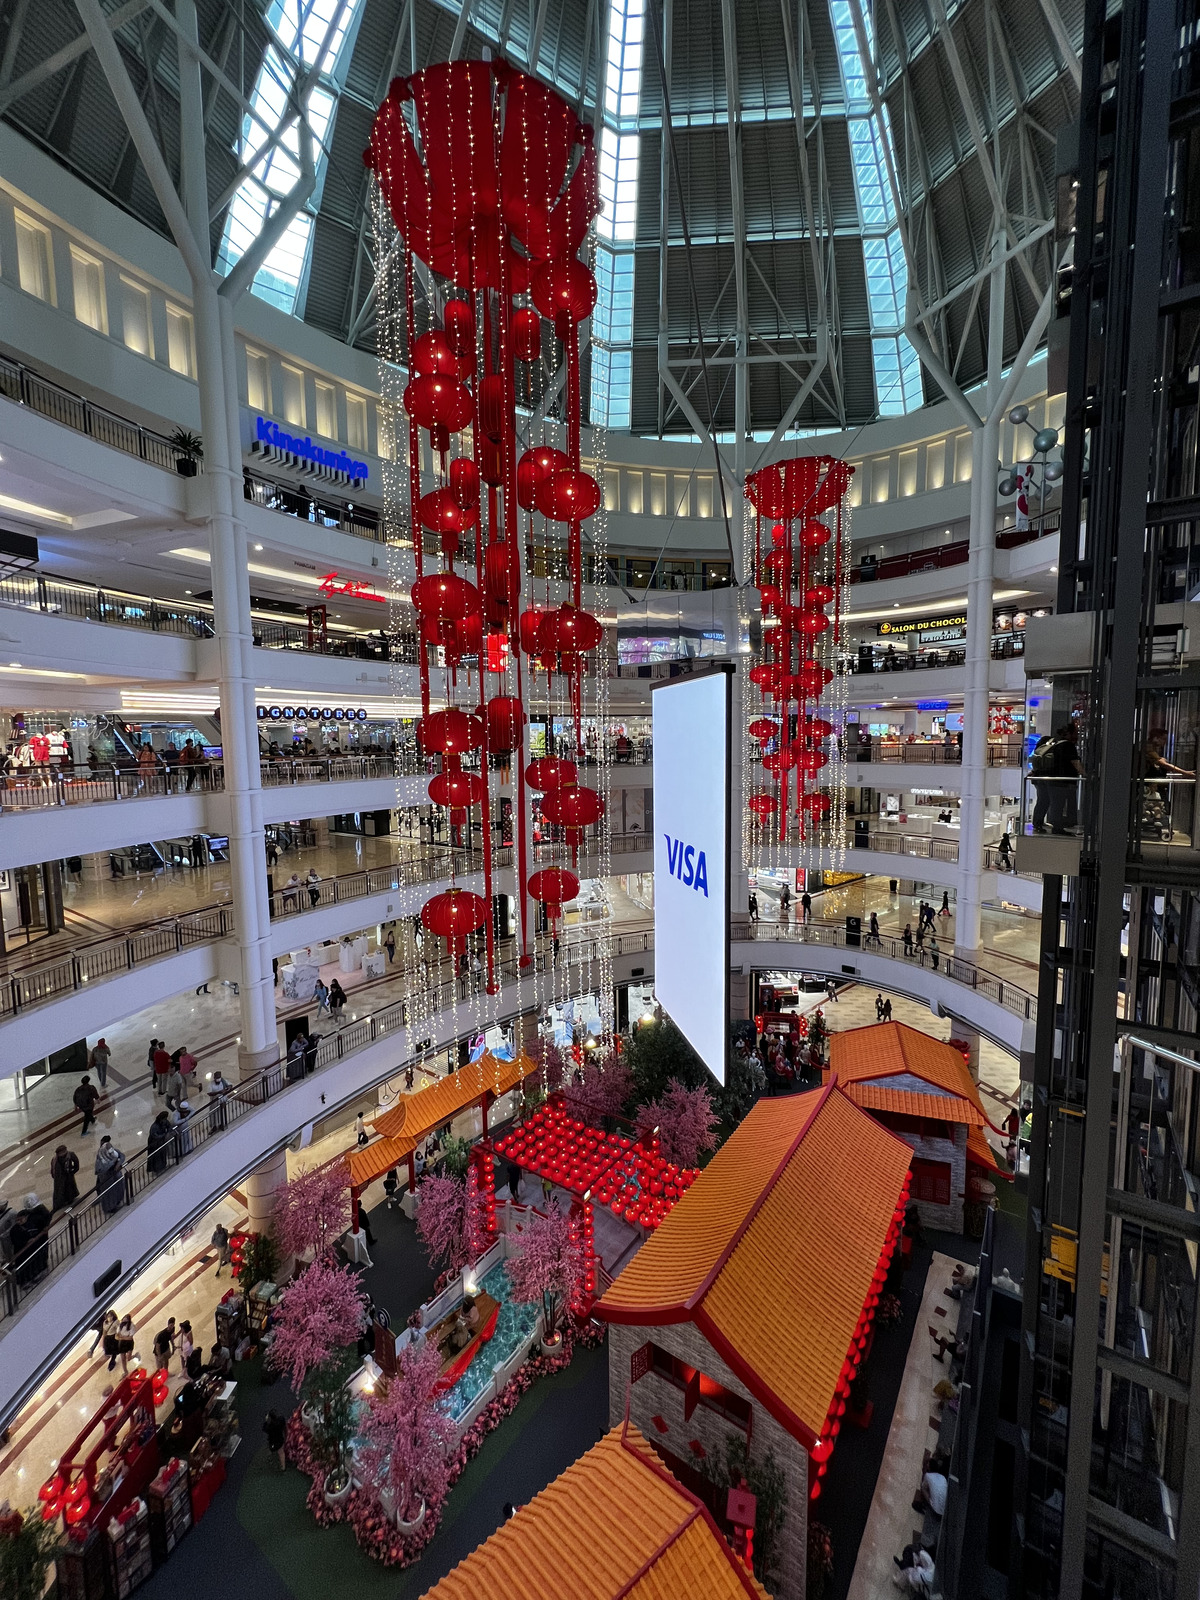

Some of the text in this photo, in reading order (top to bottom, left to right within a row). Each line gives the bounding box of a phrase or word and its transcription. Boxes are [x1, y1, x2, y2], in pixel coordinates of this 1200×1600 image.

[257, 416, 368, 479] Kinokuniya
[865, 556, 871, 564] 4
[891, 617, 967, 633] SALON DU CHOCOL
[258, 708, 366, 719] IGNATURES
[664, 833, 708, 898] VISA
[850, 918, 857, 926] G
